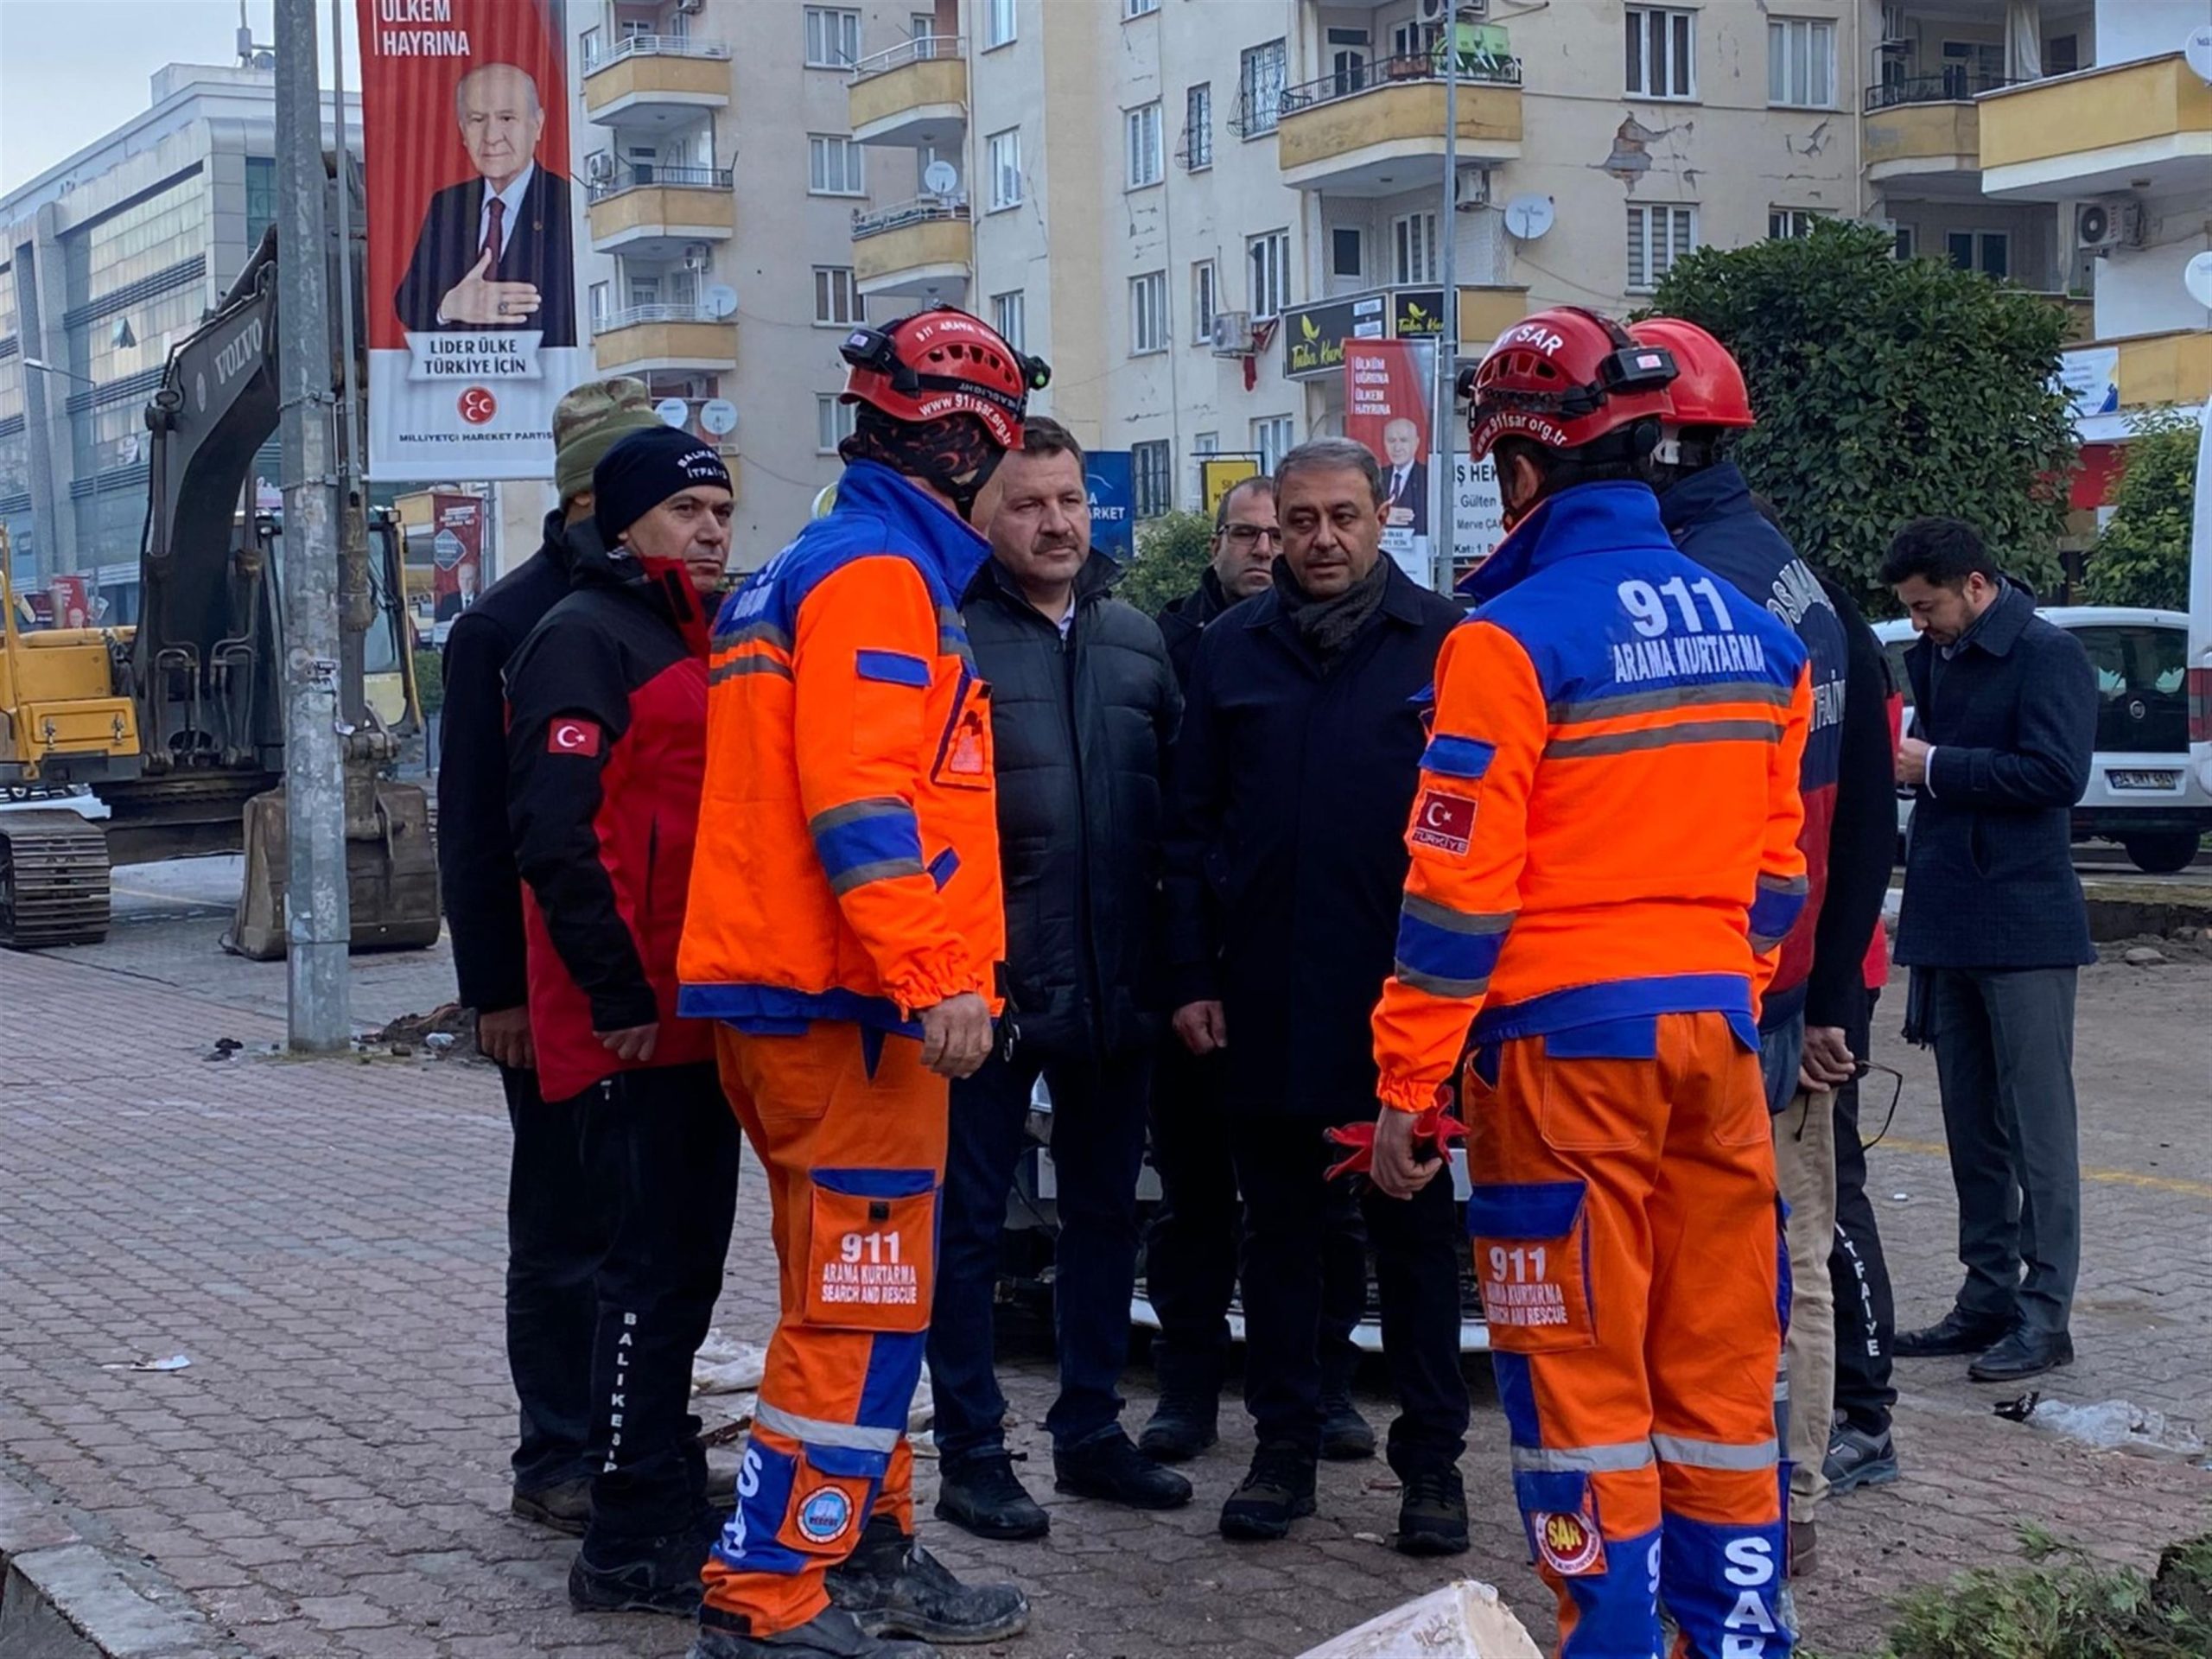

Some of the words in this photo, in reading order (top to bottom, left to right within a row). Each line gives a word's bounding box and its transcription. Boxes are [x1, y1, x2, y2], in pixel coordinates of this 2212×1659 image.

[383, 30, 471, 56] HAYRINA
[214, 317, 264, 385] VOLVO
[430, 337, 474, 354] LİDER
[479, 336, 518, 353] ÜLKE
[1516, 325, 1564, 357] SAR
[424, 357, 492, 374] TÜRKİYE
[494, 357, 526, 374] İÇİN
[1460, 494, 1497, 508] Gülten
[1617, 576, 1734, 638] 911
[1613, 639, 1678, 684] ARAMA
[1674, 633, 1767, 675] KURTARMA
[841, 1230, 900, 1265] 911
[823, 1262, 860, 1285] ARAMA
[861, 1264, 918, 1287] KURTARMA
[1489, 1246, 1547, 1283] 911
[822, 1284, 861, 1304] SEARCH
[862, 1286, 881, 1305] AND
[880, 1286, 918, 1306] RESCUE
[1526, 1306, 1569, 1326] RESCUE
[1548, 1515, 1583, 1552] SAR
